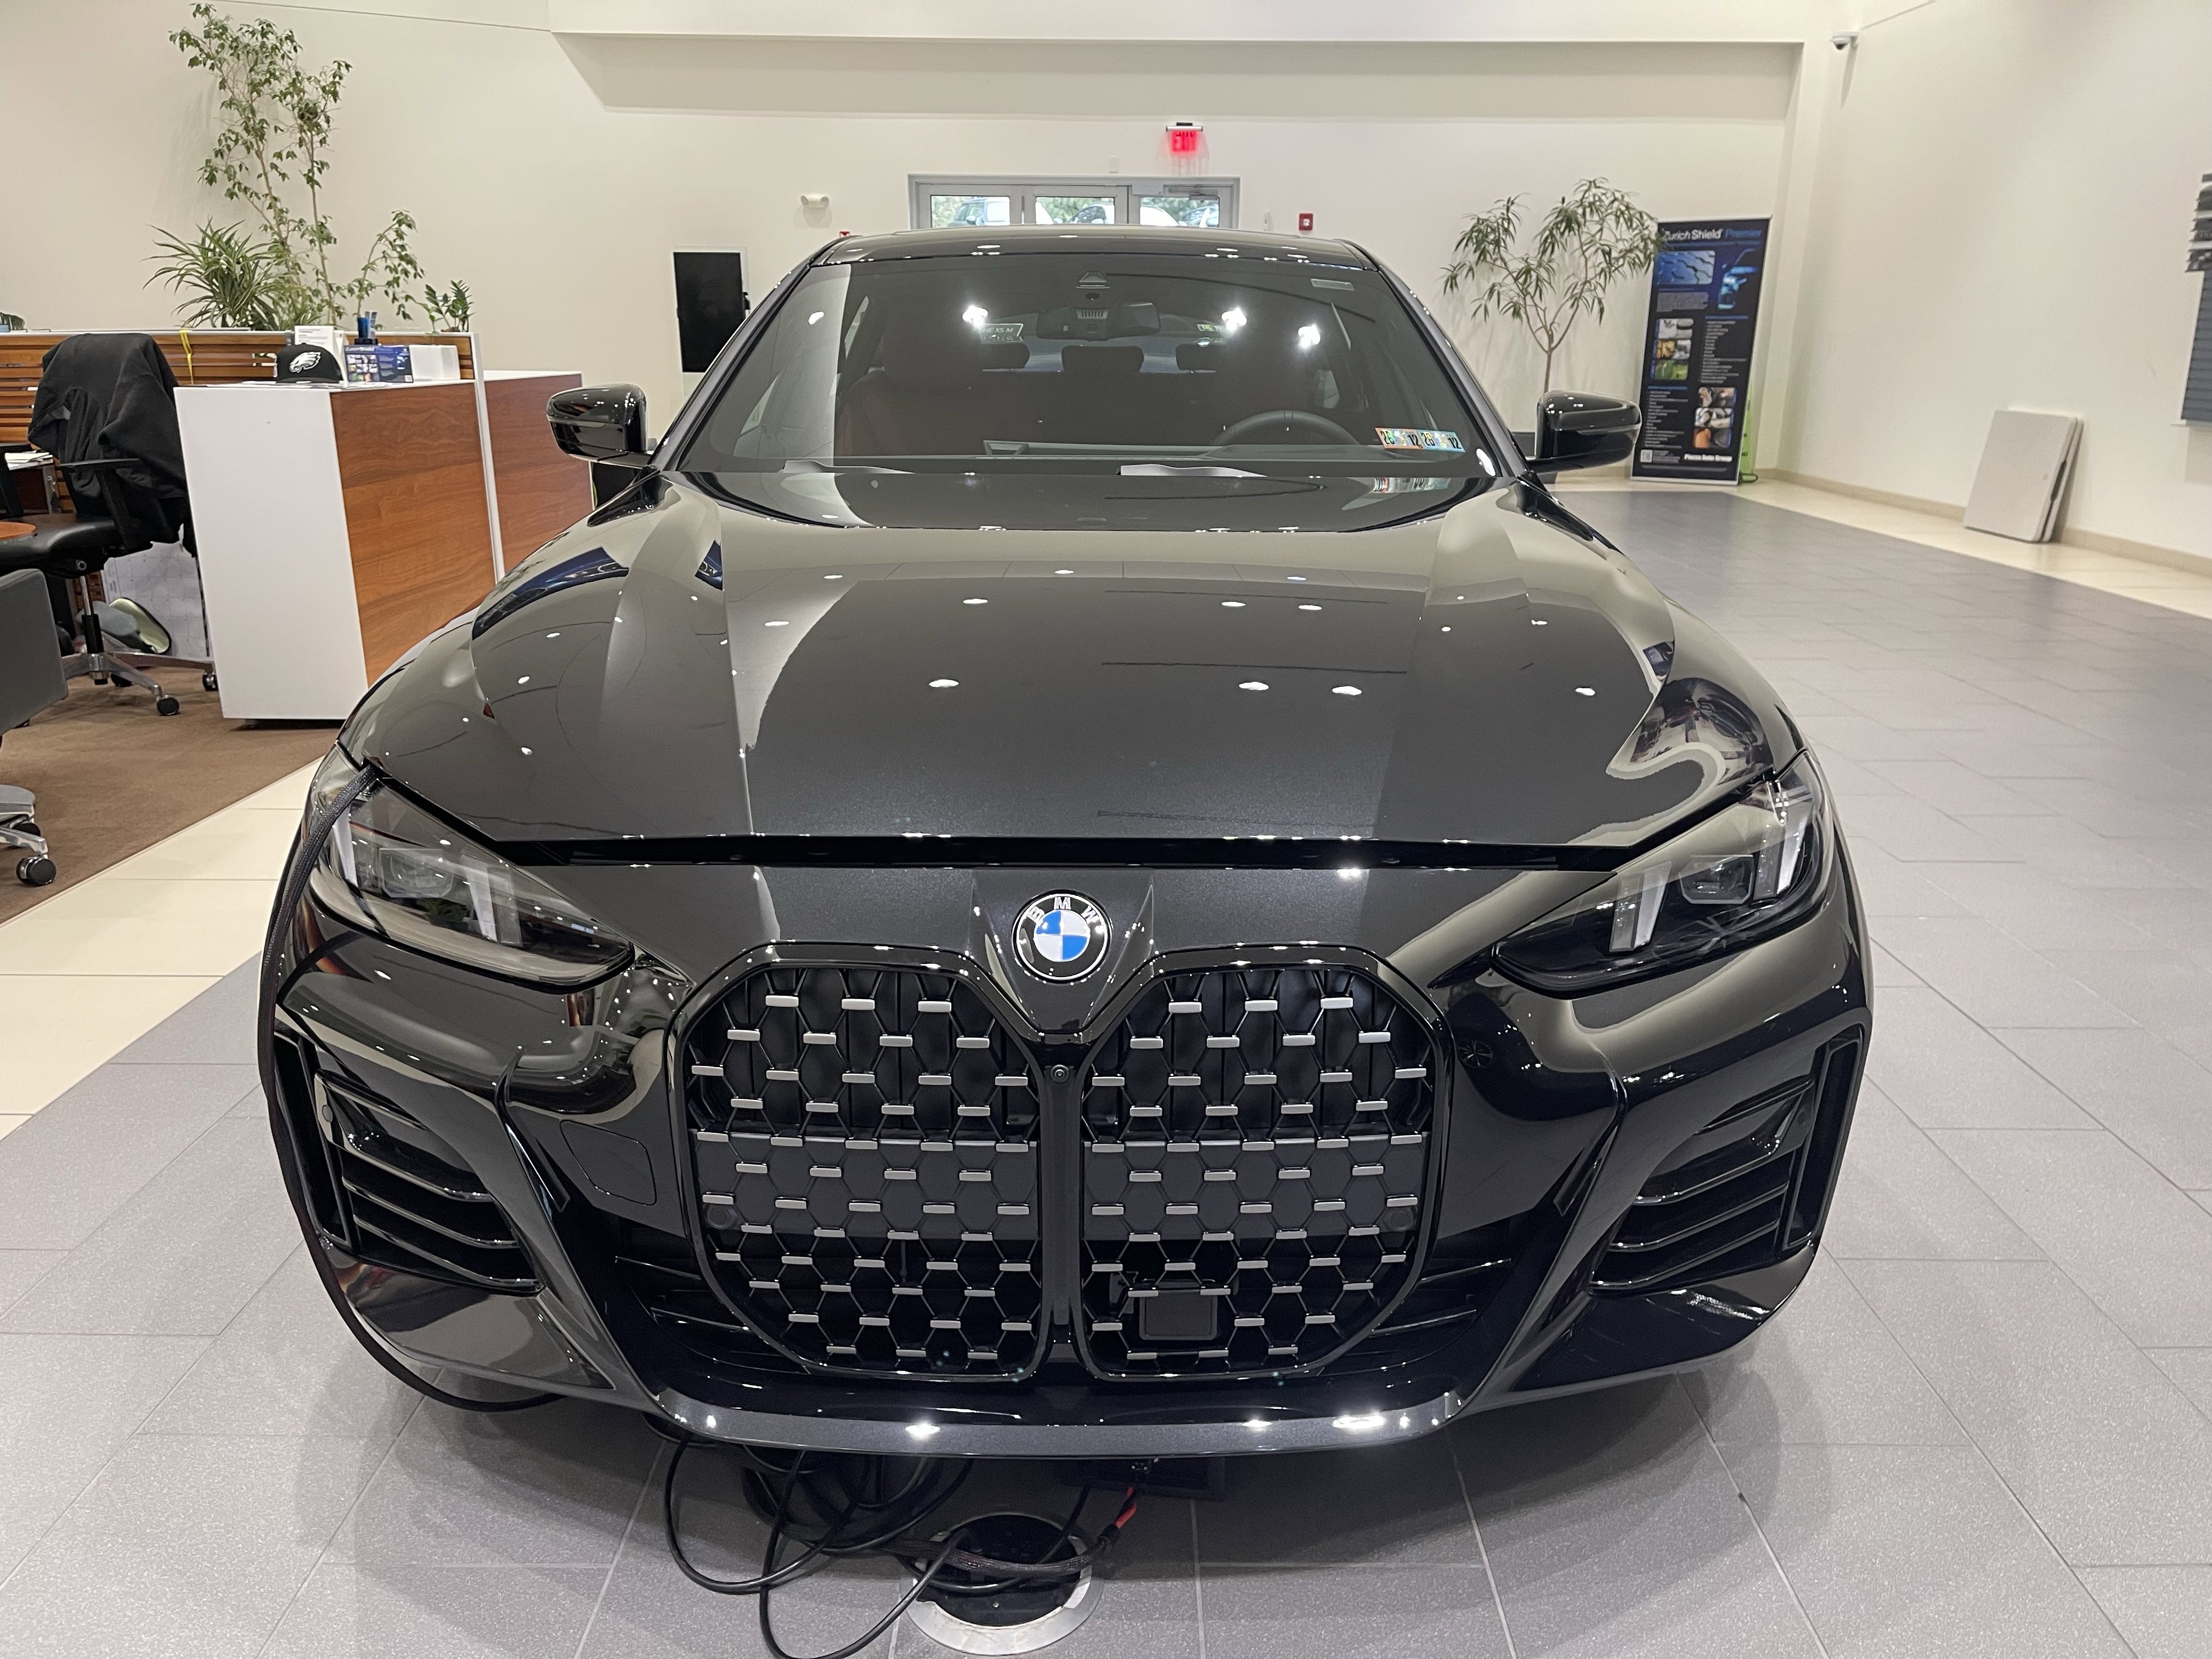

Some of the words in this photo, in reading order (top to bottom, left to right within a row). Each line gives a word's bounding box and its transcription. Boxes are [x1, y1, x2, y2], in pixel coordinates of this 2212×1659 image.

[1380, 431, 1395, 444] 26
[1407, 434, 1420, 446] 12
[1421, 432, 1436, 446] 26
[1447, 437, 1462, 449] 12
[1026, 896, 1101, 925] BMW
